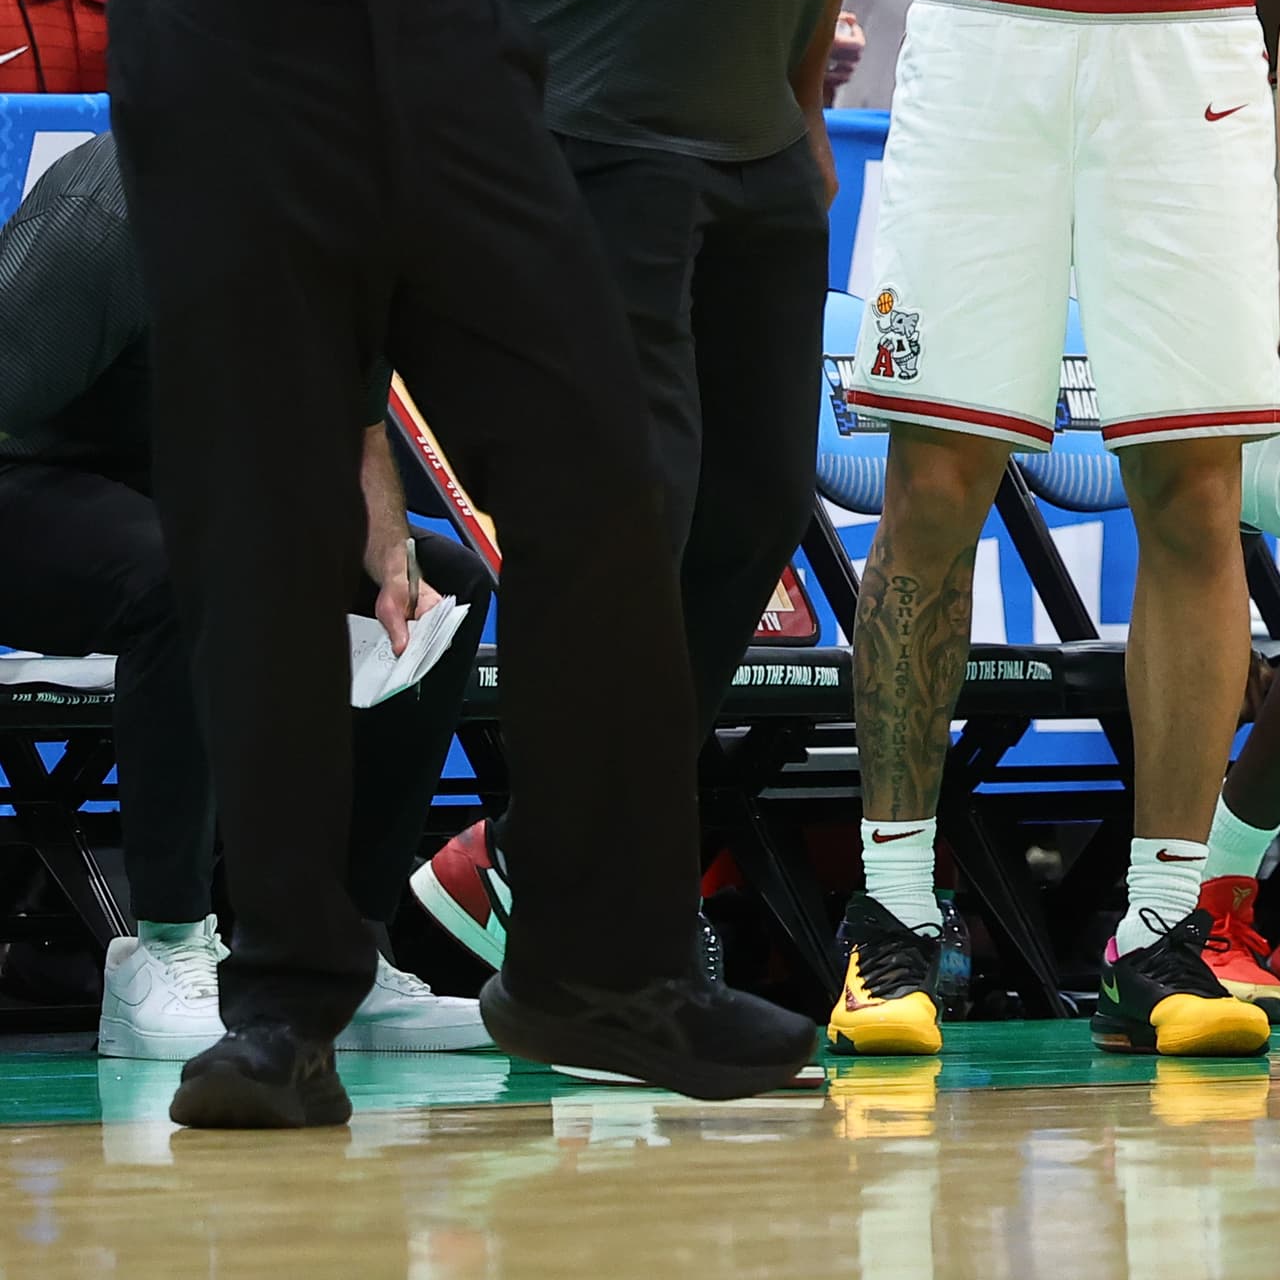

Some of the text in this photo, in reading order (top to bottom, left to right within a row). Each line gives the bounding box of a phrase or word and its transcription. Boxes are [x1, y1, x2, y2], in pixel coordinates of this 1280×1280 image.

[416, 434, 474, 517] ROLL TIDE
[479, 666, 498, 687] THE
[752, 665, 765, 686] TO
[766, 665, 785, 686] THE
[785, 665, 812, 686] FINAL
[814, 666, 839, 687] FOUR
[979, 660, 996, 681] THE
[998, 660, 1024, 681] FINAL
